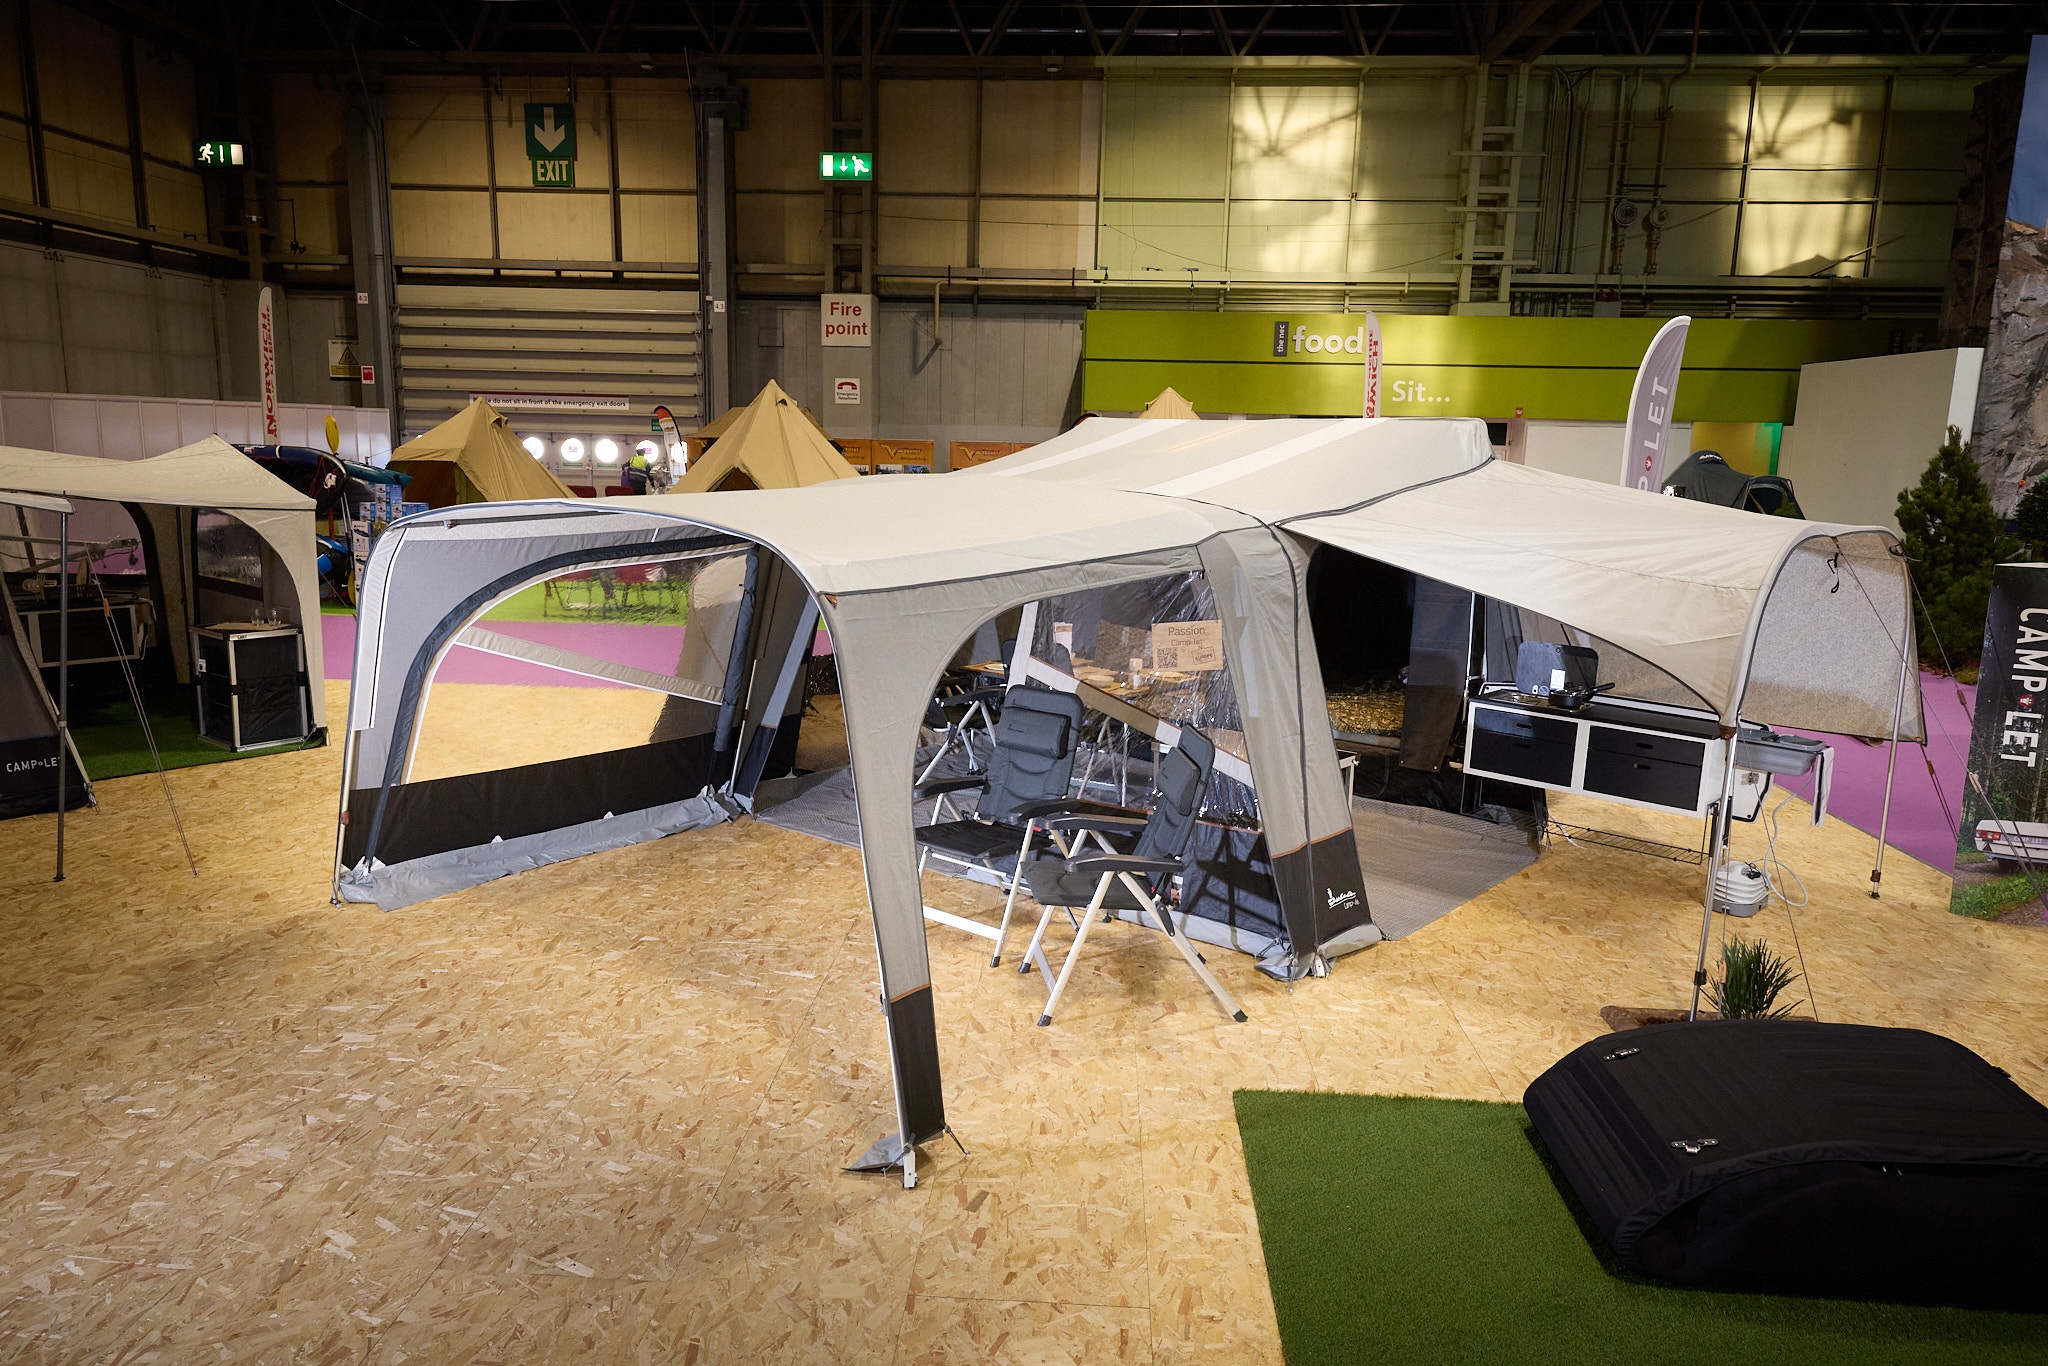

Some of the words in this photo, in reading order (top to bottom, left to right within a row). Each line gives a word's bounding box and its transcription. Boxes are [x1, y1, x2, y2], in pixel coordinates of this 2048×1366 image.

[537, 160, 568, 181] EXIT
[830, 302, 862, 316] Fire
[825, 322, 868, 337] point
[1292, 325, 1363, 354] food
[262, 312, 275, 435] NORWICH
[1392, 380, 1450, 402] Sit...
[1644, 376, 1668, 450] LET
[1168, 625, 1206, 636] Passion
[2011, 607, 2048, 692] CAMP
[2001, 710, 2043, 768] LET
[6, 760, 38, 772] CAMP
[43, 757, 61, 768] LE
